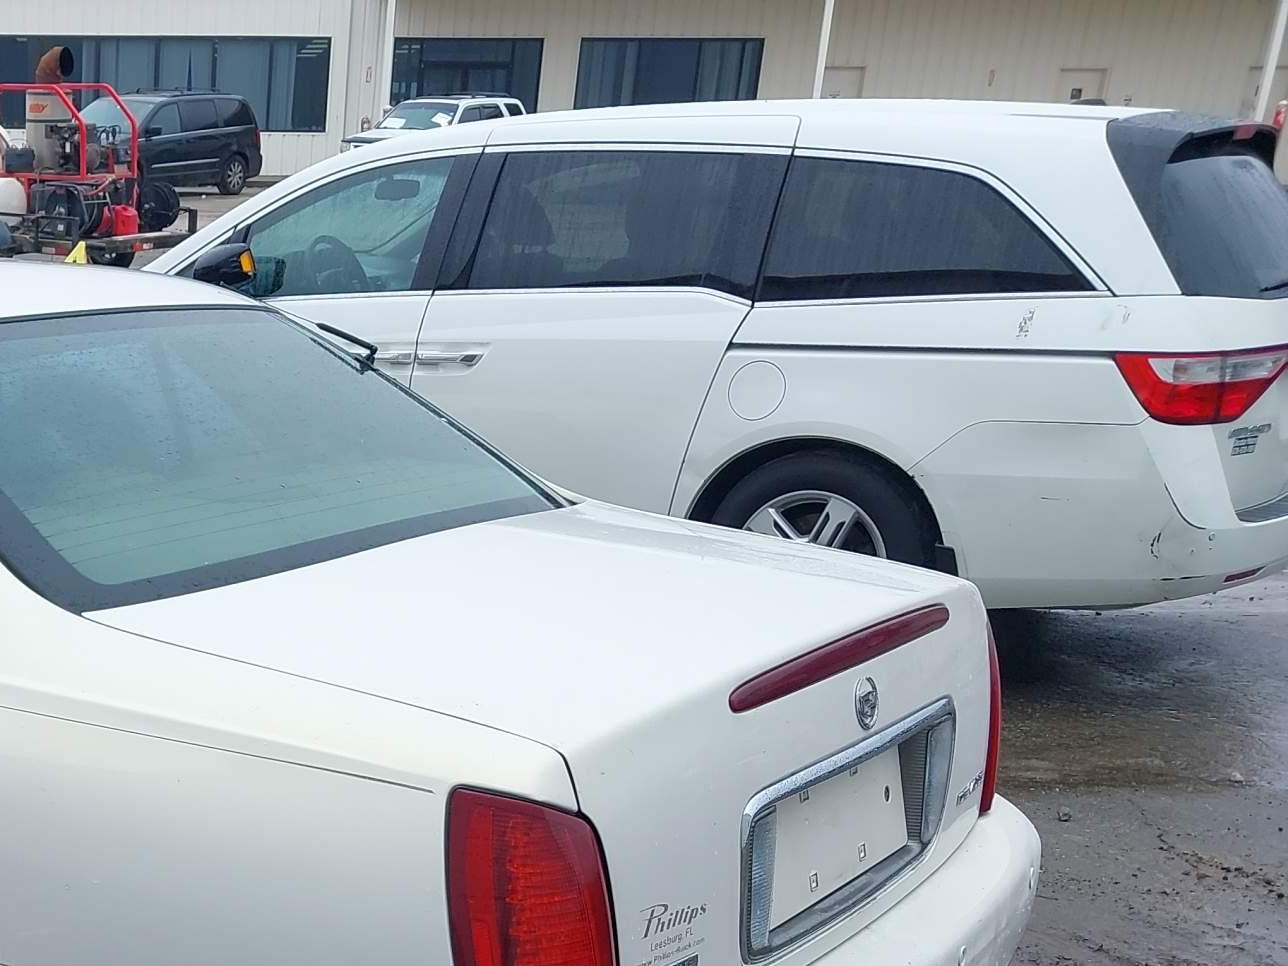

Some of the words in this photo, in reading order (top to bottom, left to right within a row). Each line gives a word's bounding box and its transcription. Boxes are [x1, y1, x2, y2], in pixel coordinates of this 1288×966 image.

[640, 902, 707, 939] Phillips
[650, 933, 683, 952] Leesburg
[685, 927, 694, 937] FL
